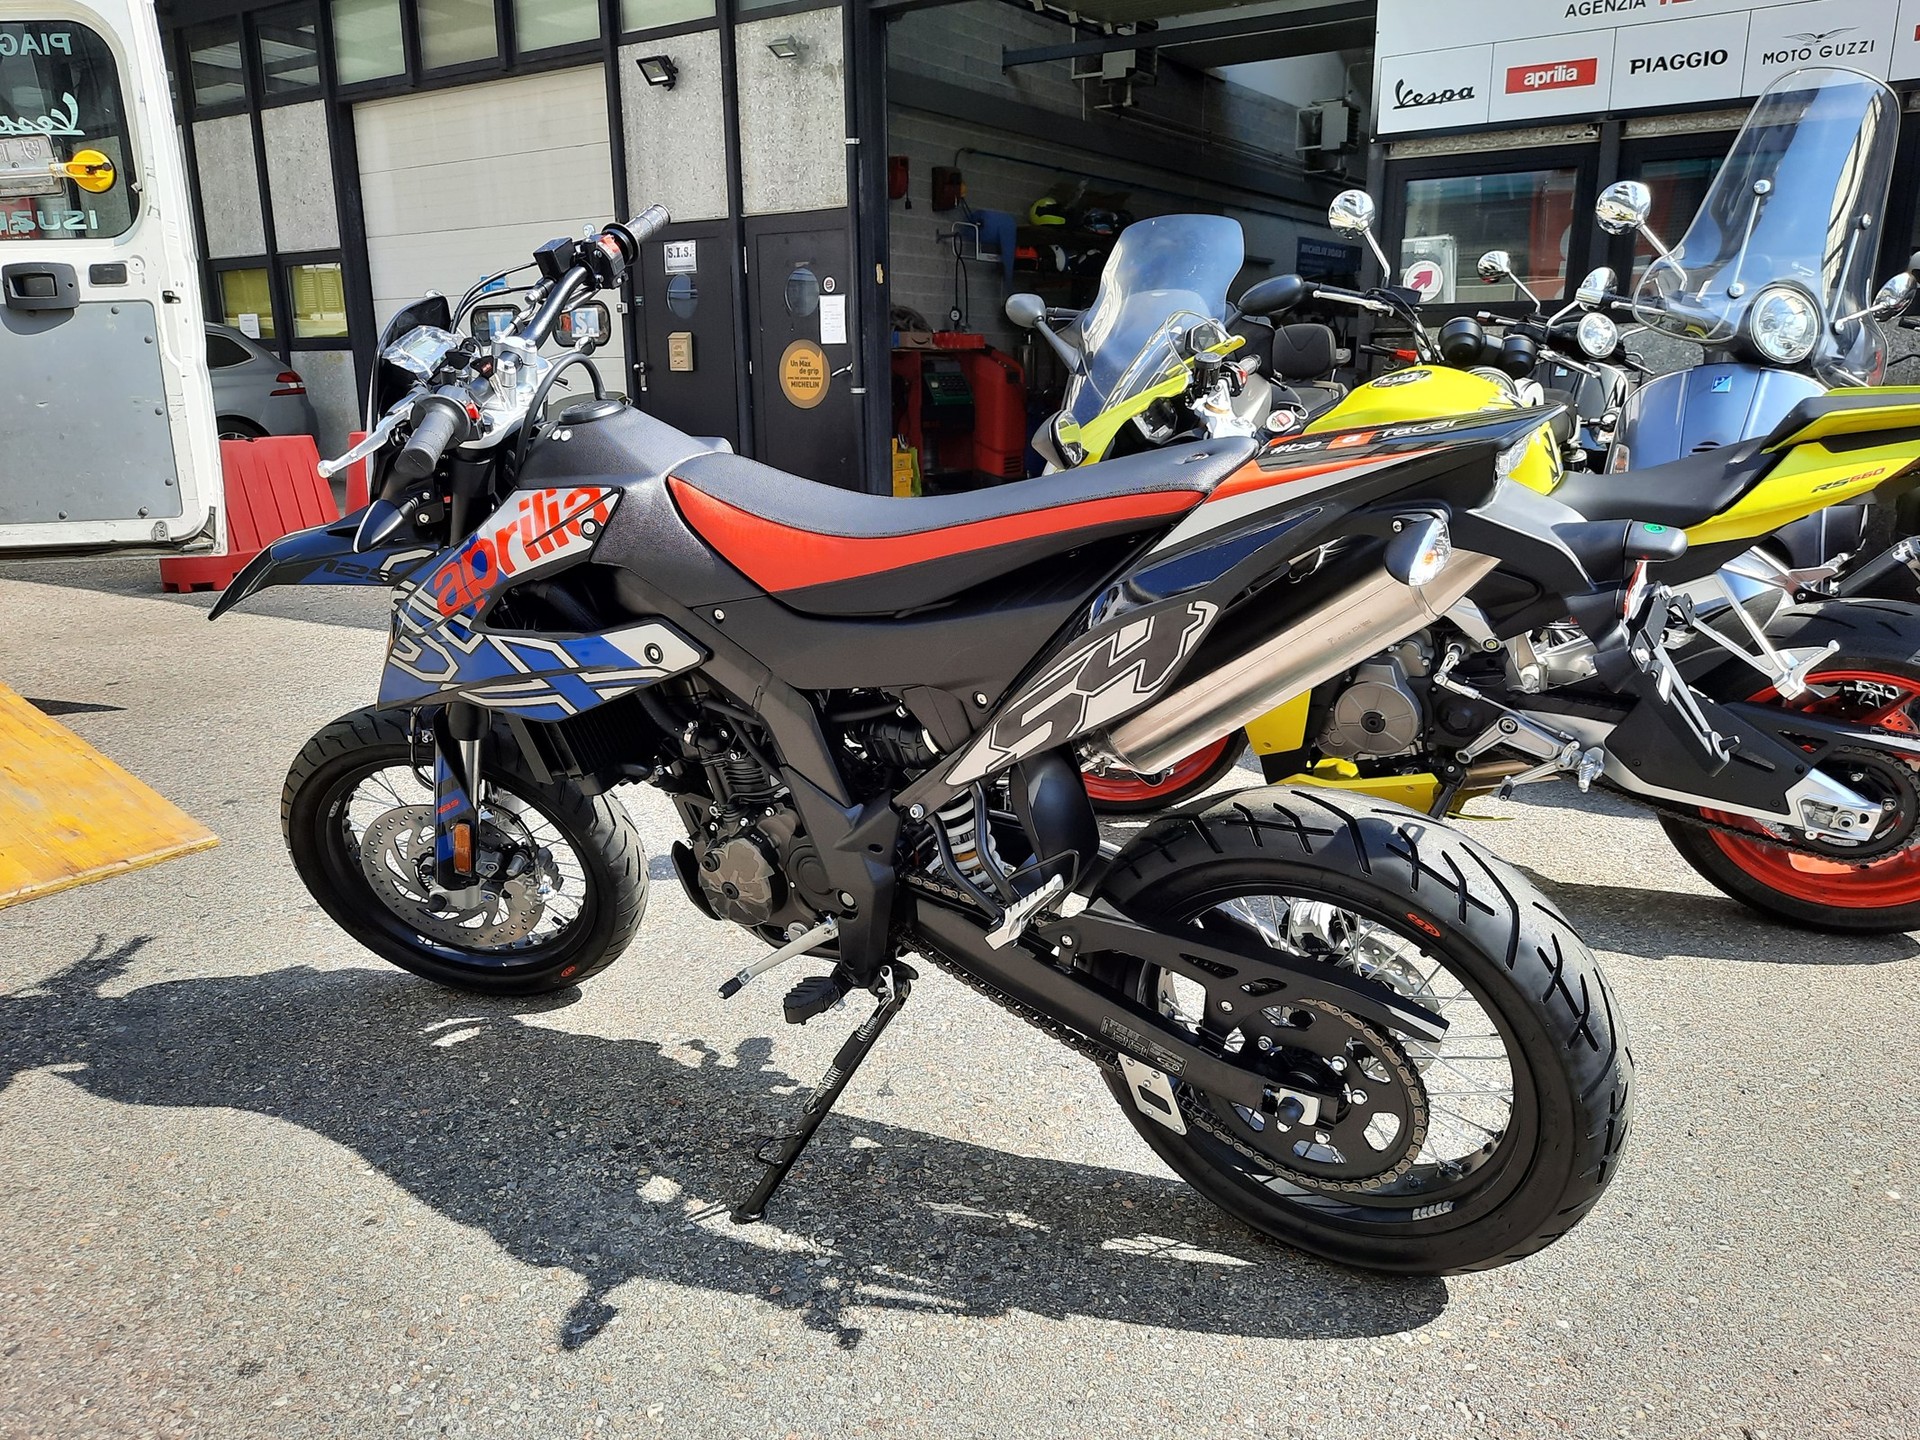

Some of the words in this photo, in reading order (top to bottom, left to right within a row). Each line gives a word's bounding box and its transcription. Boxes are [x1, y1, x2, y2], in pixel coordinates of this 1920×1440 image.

[1564, 0, 1647, 19] AGENZIA
[1629, 49, 1729, 75] PIAGGIO
[1762, 48, 1812, 66] MOTO
[1819, 39, 1876, 59] GUZZI
[1523, 65, 1578, 88] aprilia
[1393, 78, 1475, 110] Vespa
[668, 246, 692, 259] S.I.S.
[807, 367, 819, 375] grip
[790, 380, 819, 388] MICHELIN
[433, 486, 610, 617] aprilia
